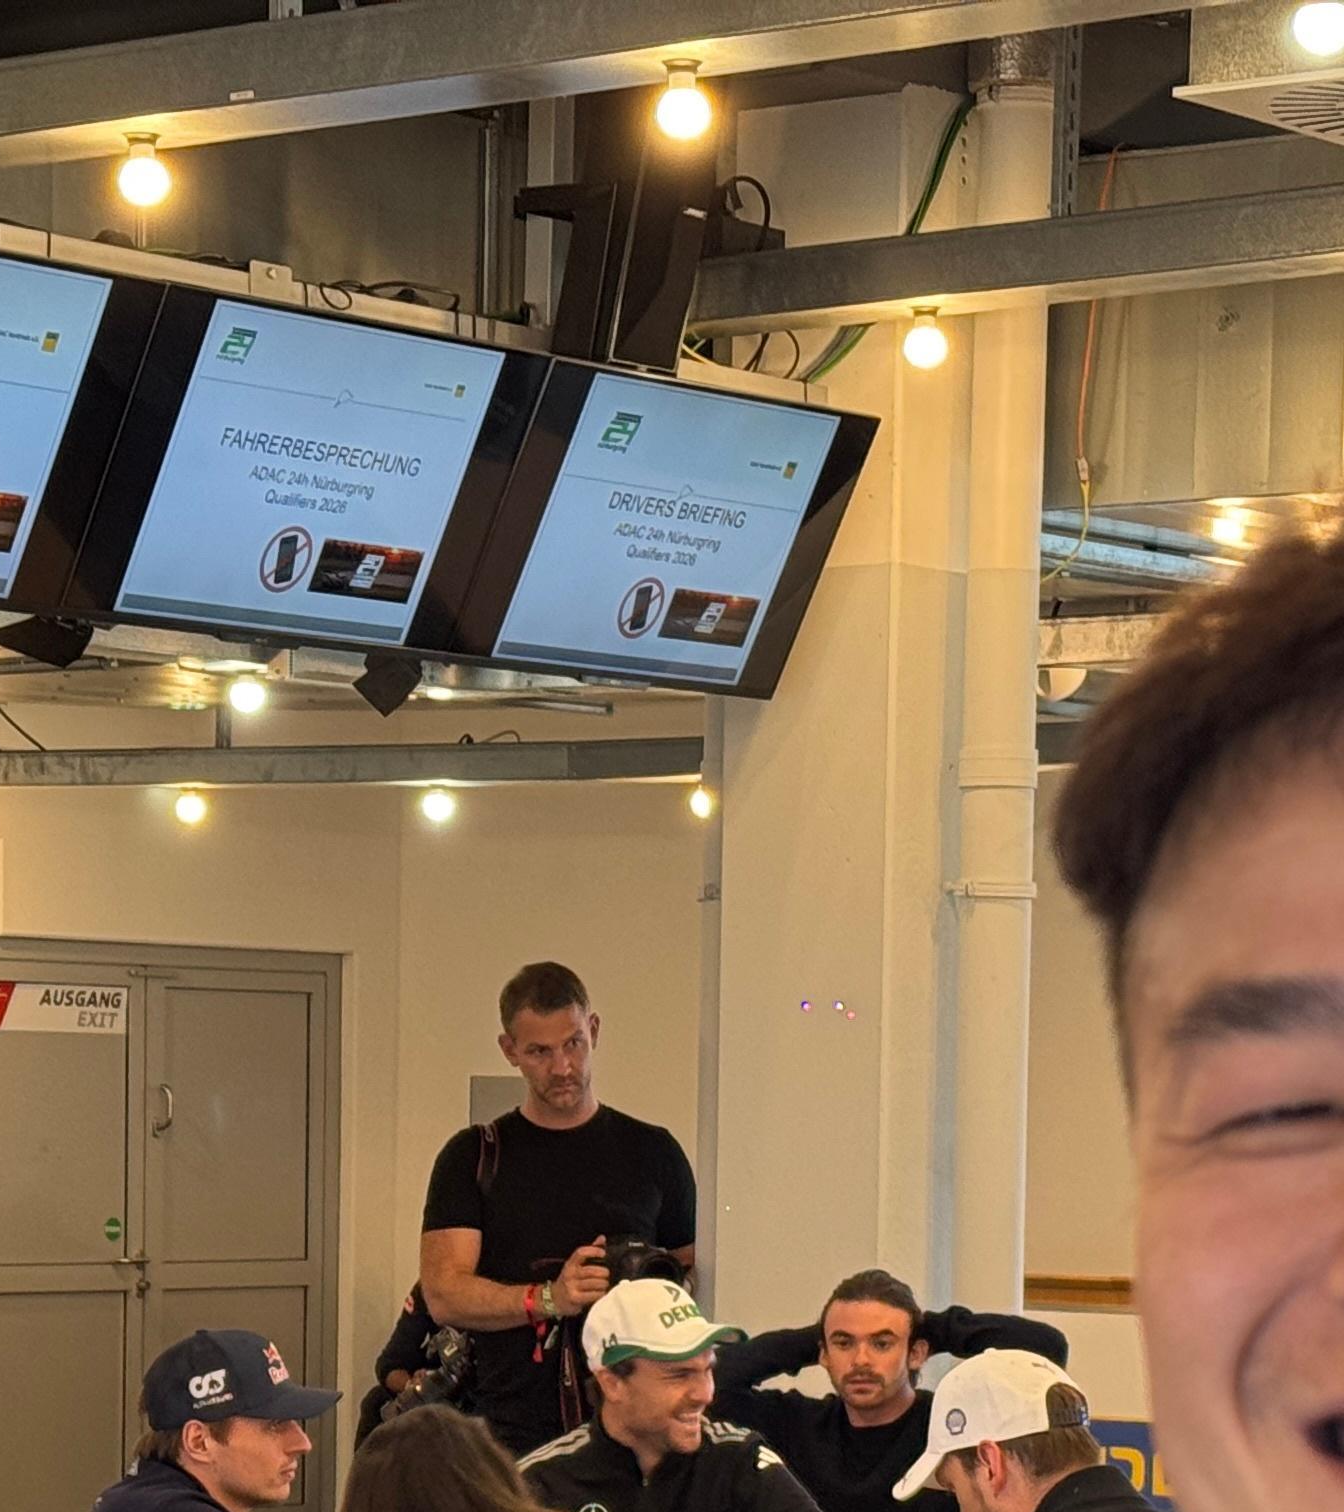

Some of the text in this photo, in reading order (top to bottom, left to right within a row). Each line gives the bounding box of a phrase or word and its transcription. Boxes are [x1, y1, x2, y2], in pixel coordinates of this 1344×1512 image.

[220, 427, 422, 477] FAHRERBESPRECHUNG
[249, 465, 375, 501] ADAC 24h Nürburgring
[264, 489, 348, 514] Qualifiers 2026
[608, 491, 747, 529] DRIVERS BRIEFING
[613, 522, 647, 540] ADAC
[40, 989, 122, 1008] AUSGANG
[77, 1011, 118, 1028] EXIT
